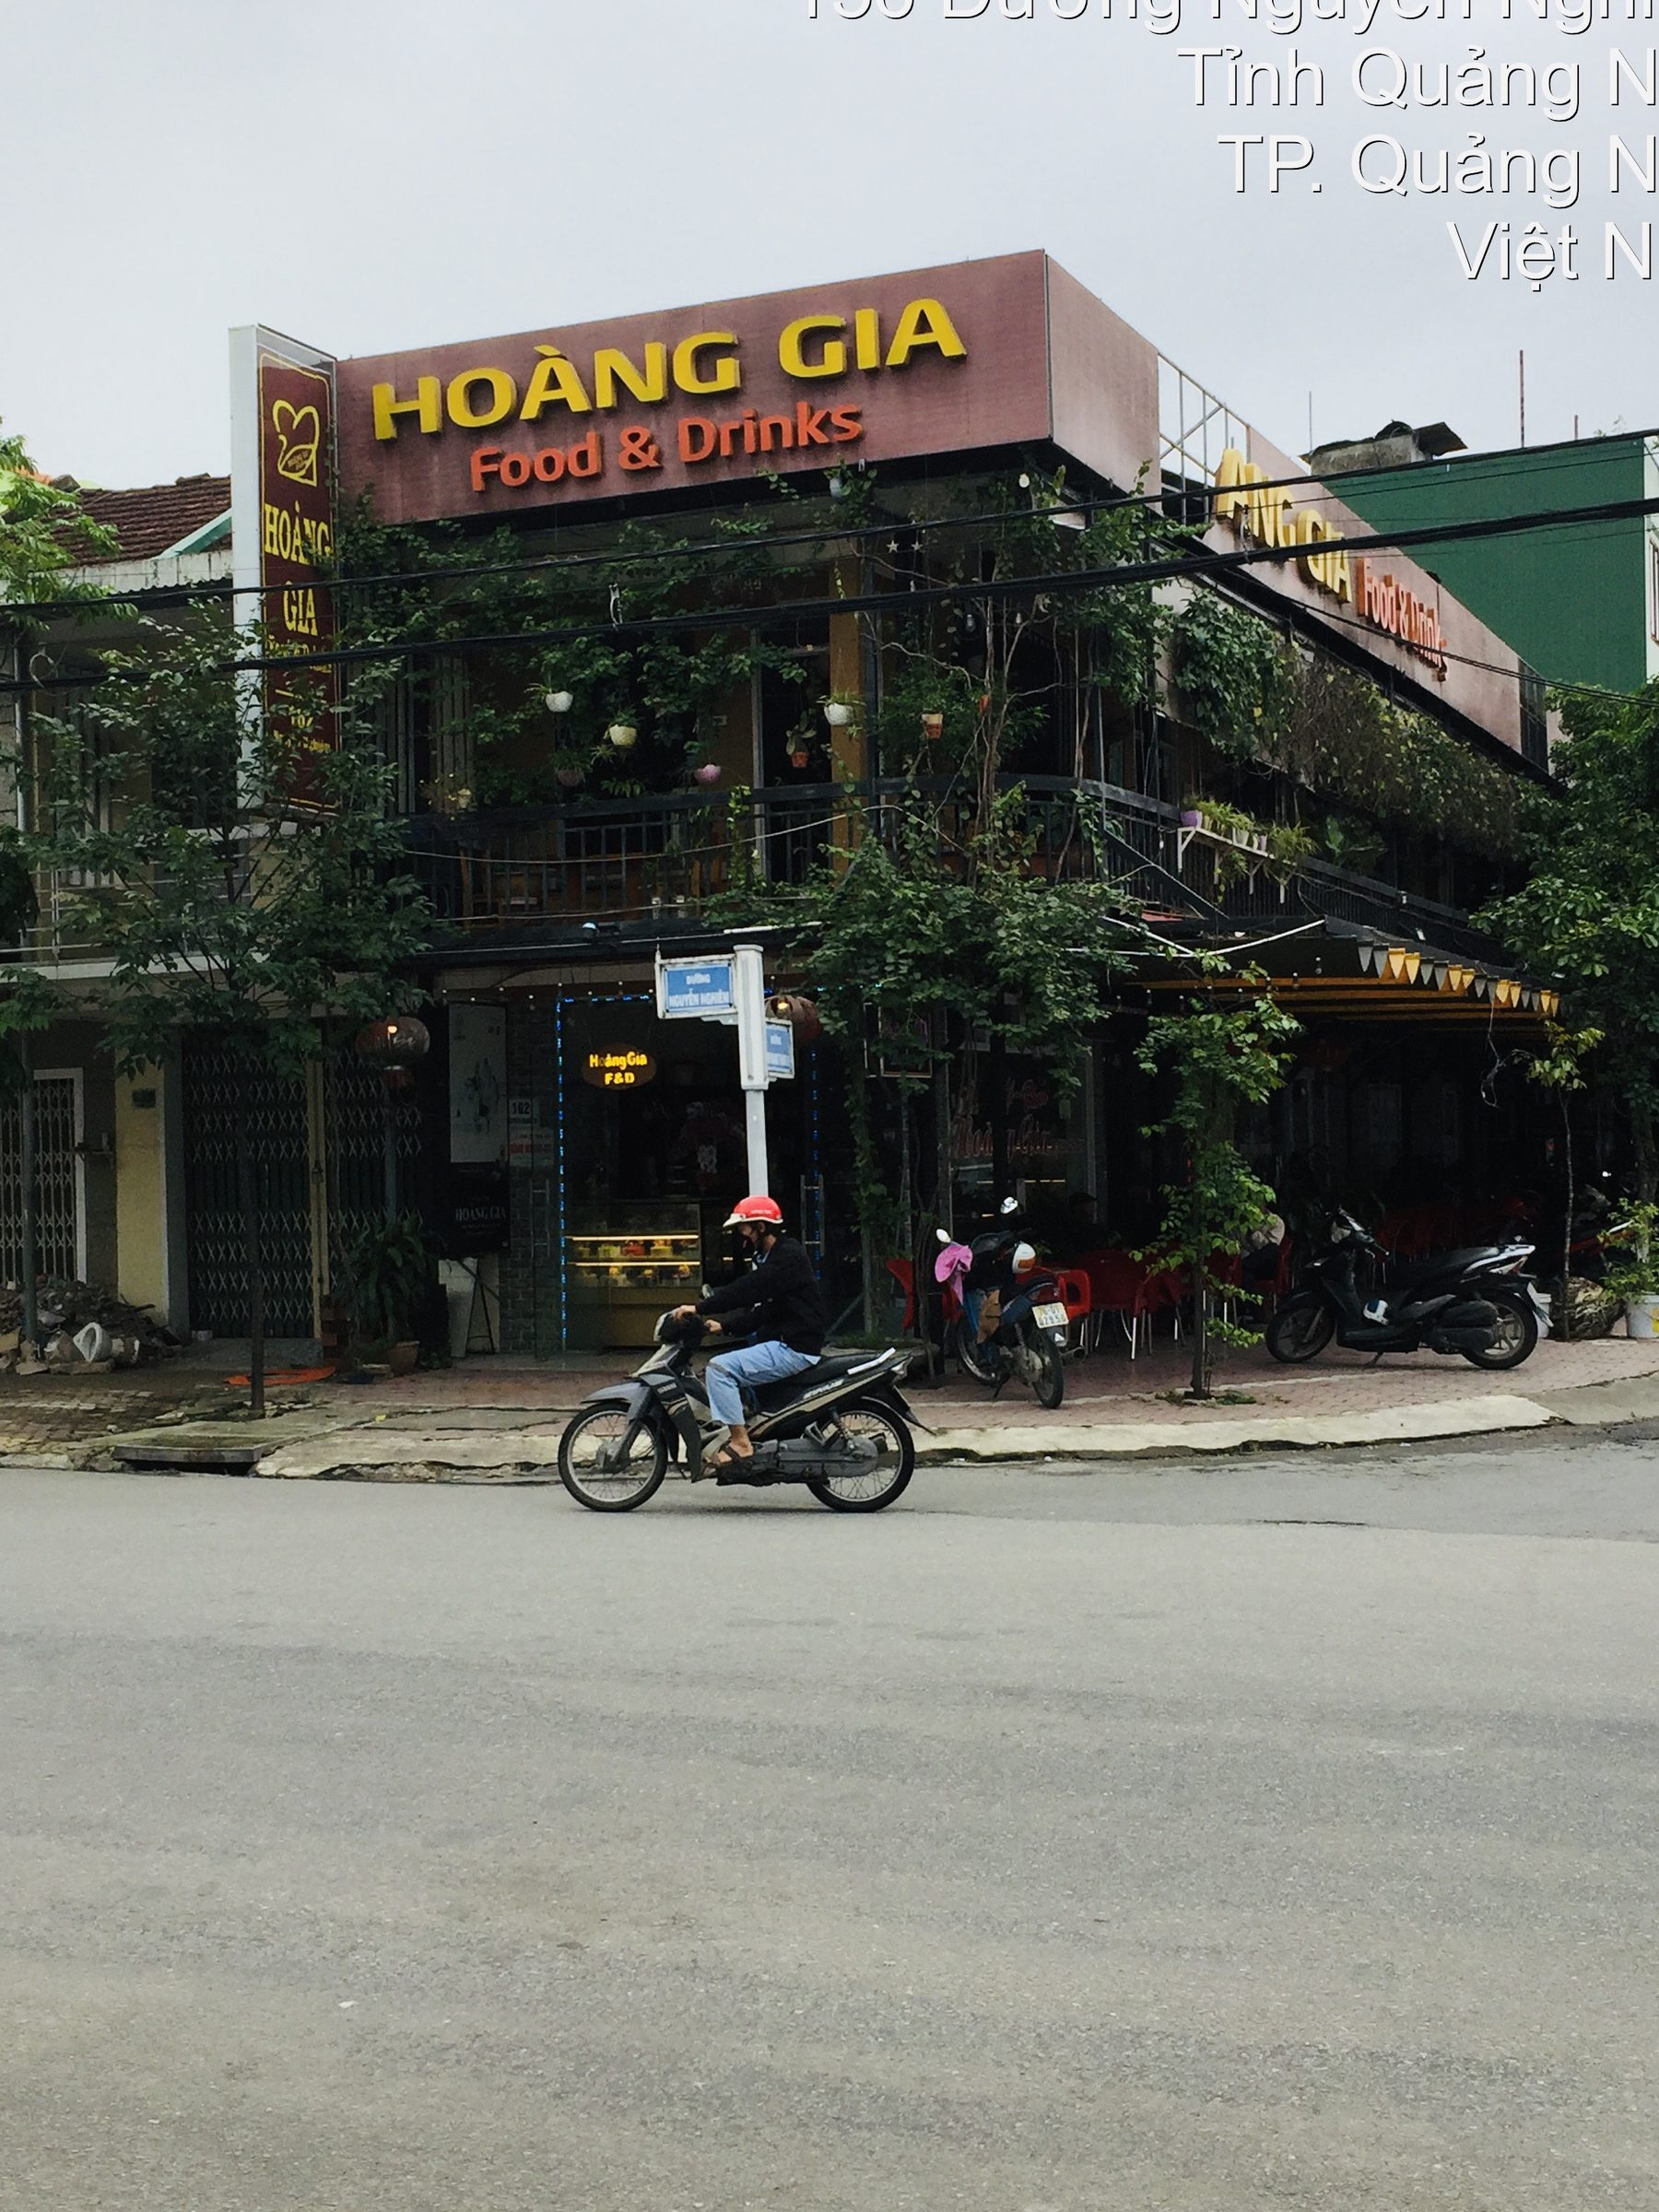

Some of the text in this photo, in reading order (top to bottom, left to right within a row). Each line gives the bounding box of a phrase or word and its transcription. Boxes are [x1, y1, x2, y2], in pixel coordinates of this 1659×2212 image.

[372, 297, 968, 441] HOÀNG GIA
[471, 401, 865, 492] Food & Drinks
[283, 580, 318, 637] GIA
[1297, 509, 1353, 605] GIA
[1356, 557, 1398, 634] Food
